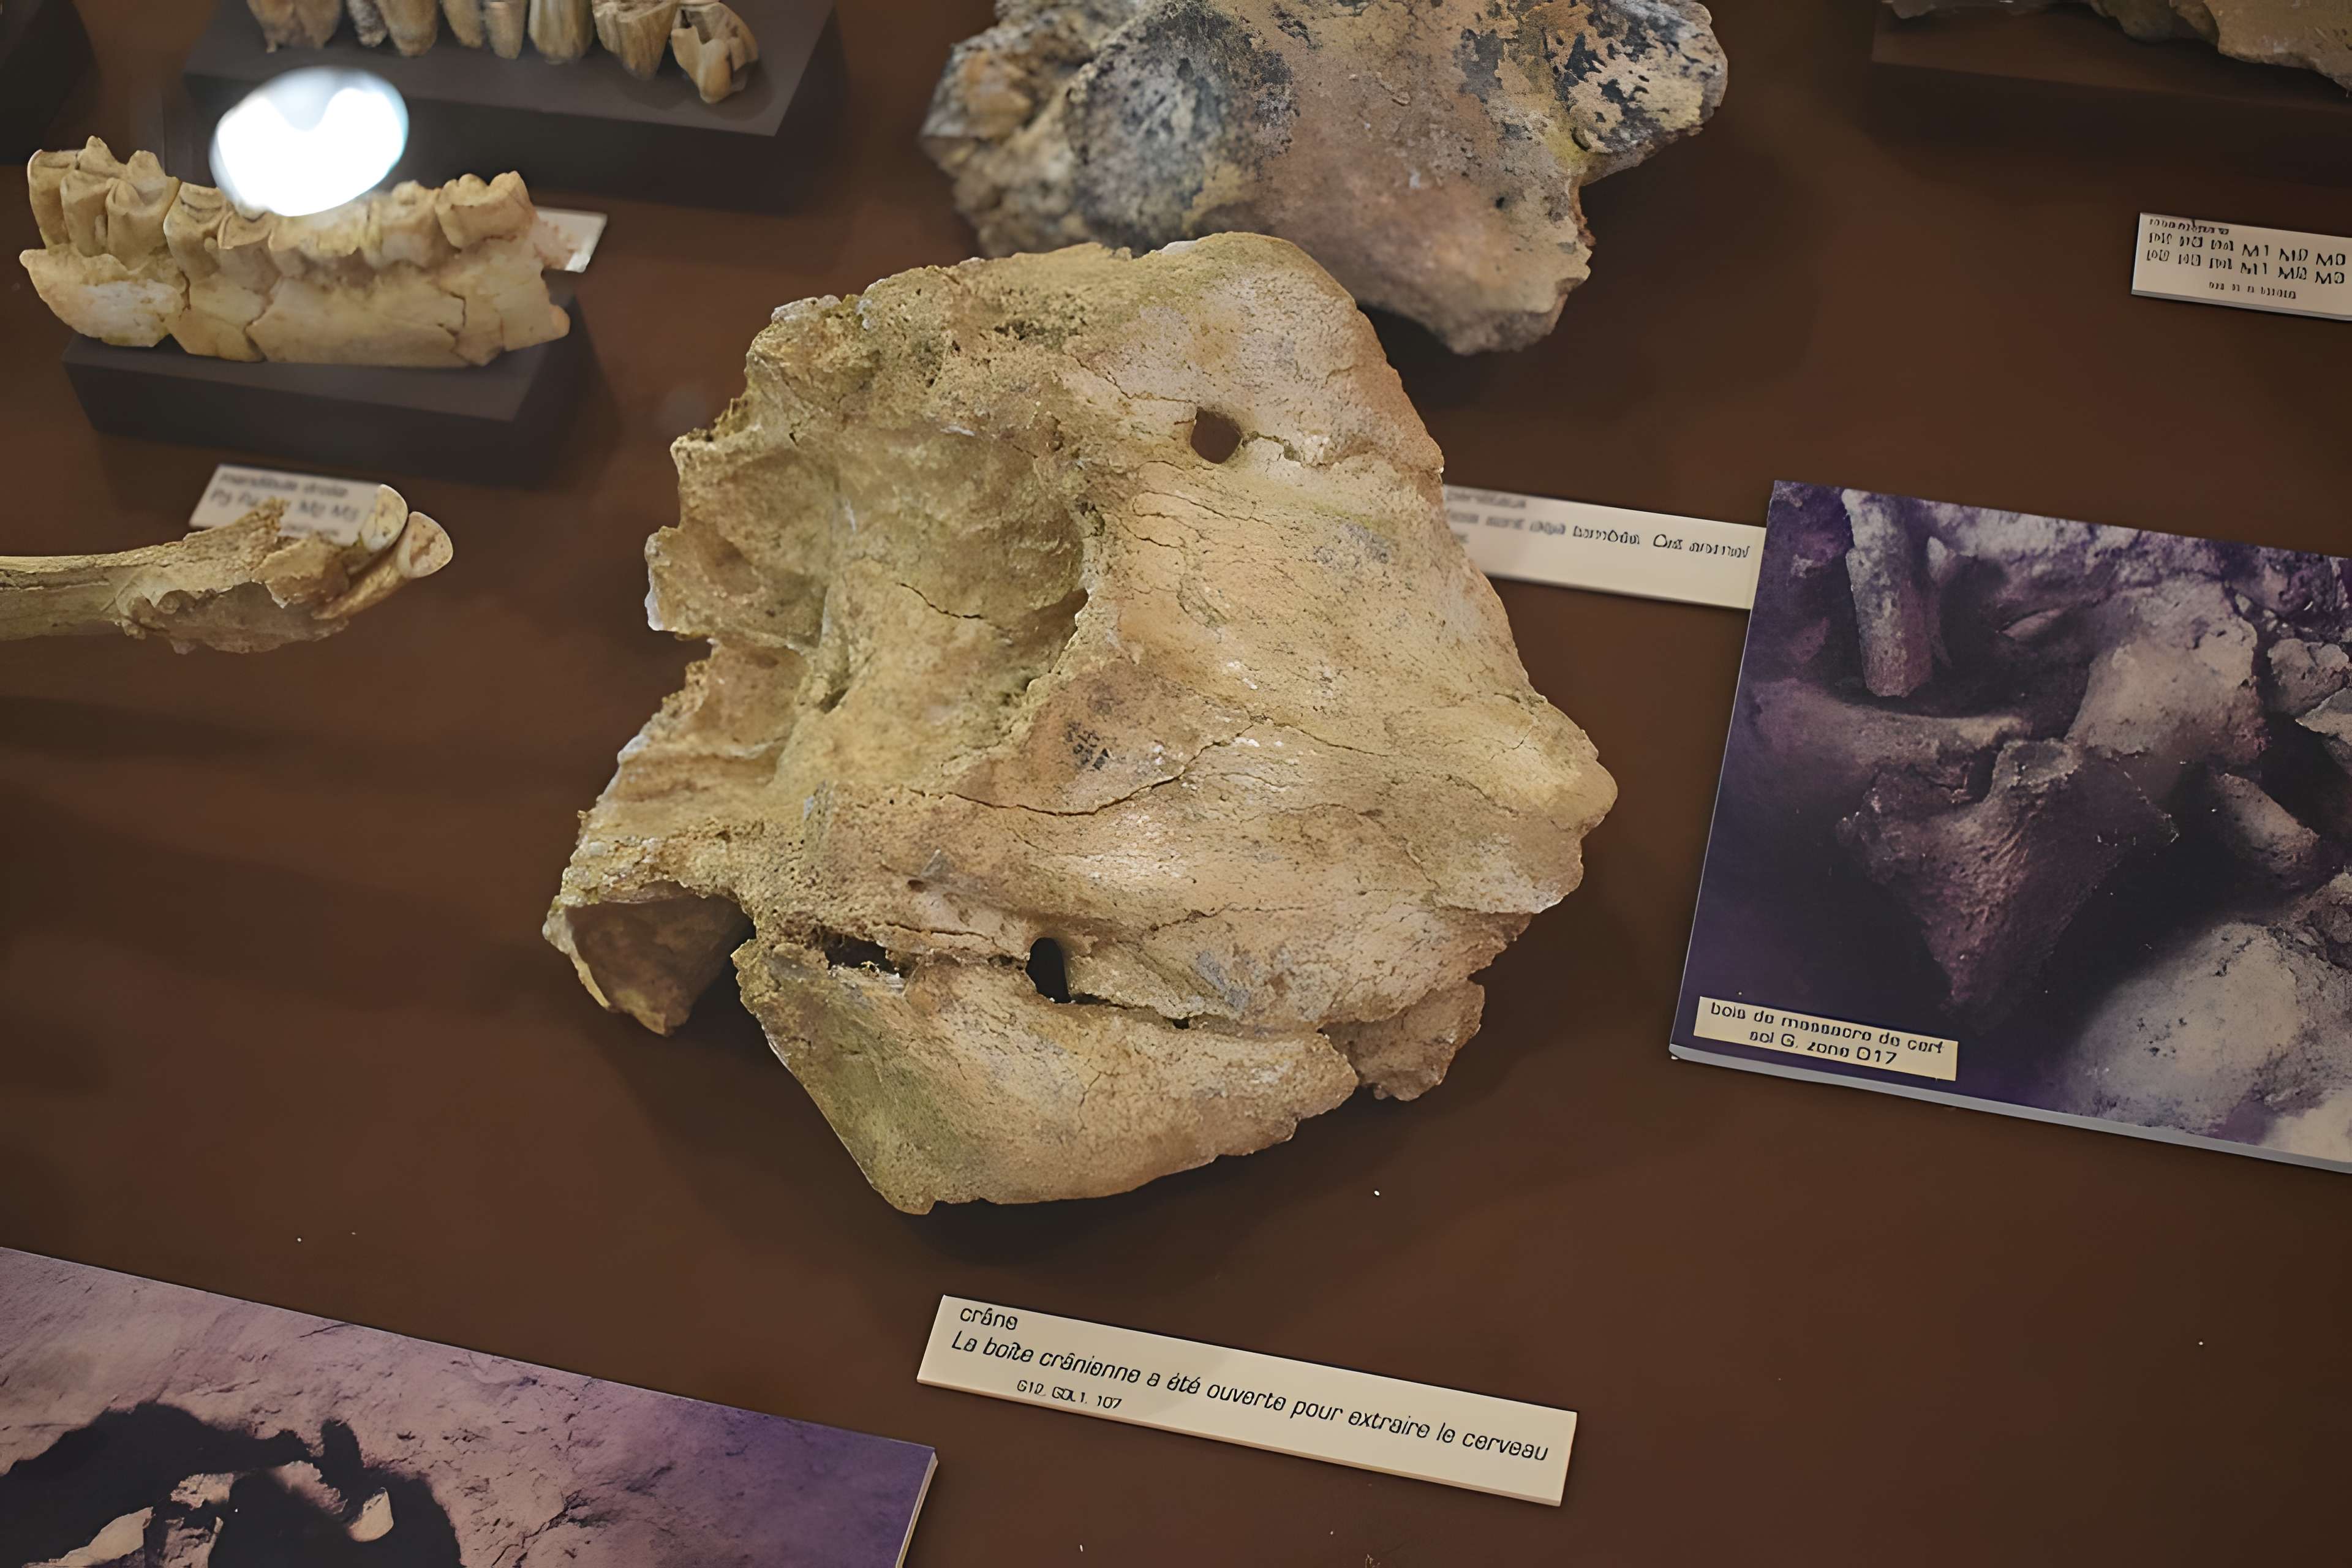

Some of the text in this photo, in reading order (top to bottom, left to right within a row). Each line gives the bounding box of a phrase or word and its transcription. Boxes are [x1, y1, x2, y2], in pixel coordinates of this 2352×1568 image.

[951, 1330, 1549, 1461] La boîte crânienne a été ouverte pour extraire le cerveau
